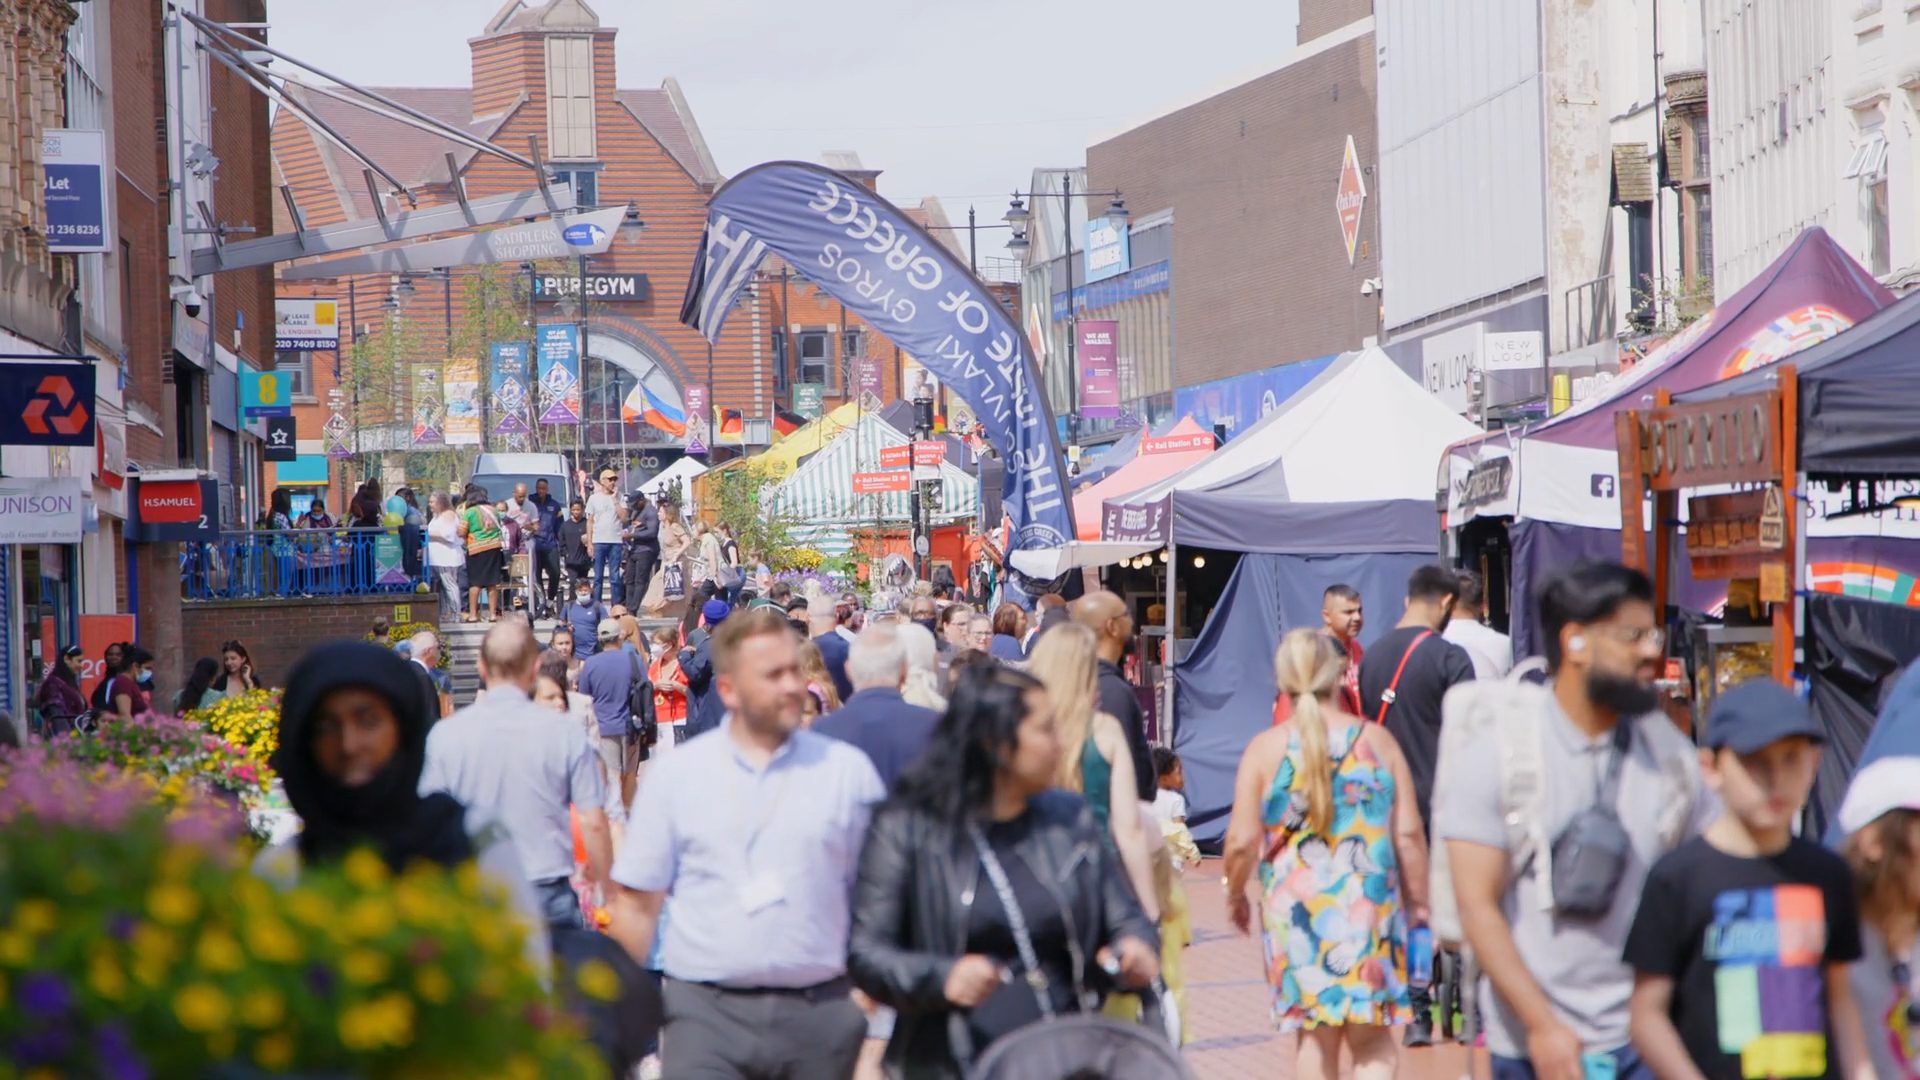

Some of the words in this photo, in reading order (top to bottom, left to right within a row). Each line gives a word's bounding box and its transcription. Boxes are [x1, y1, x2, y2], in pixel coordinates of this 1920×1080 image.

[49, 177, 70, 190] Let
[57, 225, 75, 235] 236
[77, 225, 100, 235] 8236
[808, 181, 942, 290] GREECE
[818, 243, 916, 323] GYROS
[937, 290, 989, 334] OF
[293, 340, 316, 348] 7409
[1494, 341, 1531, 350] NEW
[1491, 352, 1535, 362] LOOK
[1155, 441, 1167, 449] Rail
[1168, 440, 1191, 448] Station
[1023, 443, 1062, 521] THE
